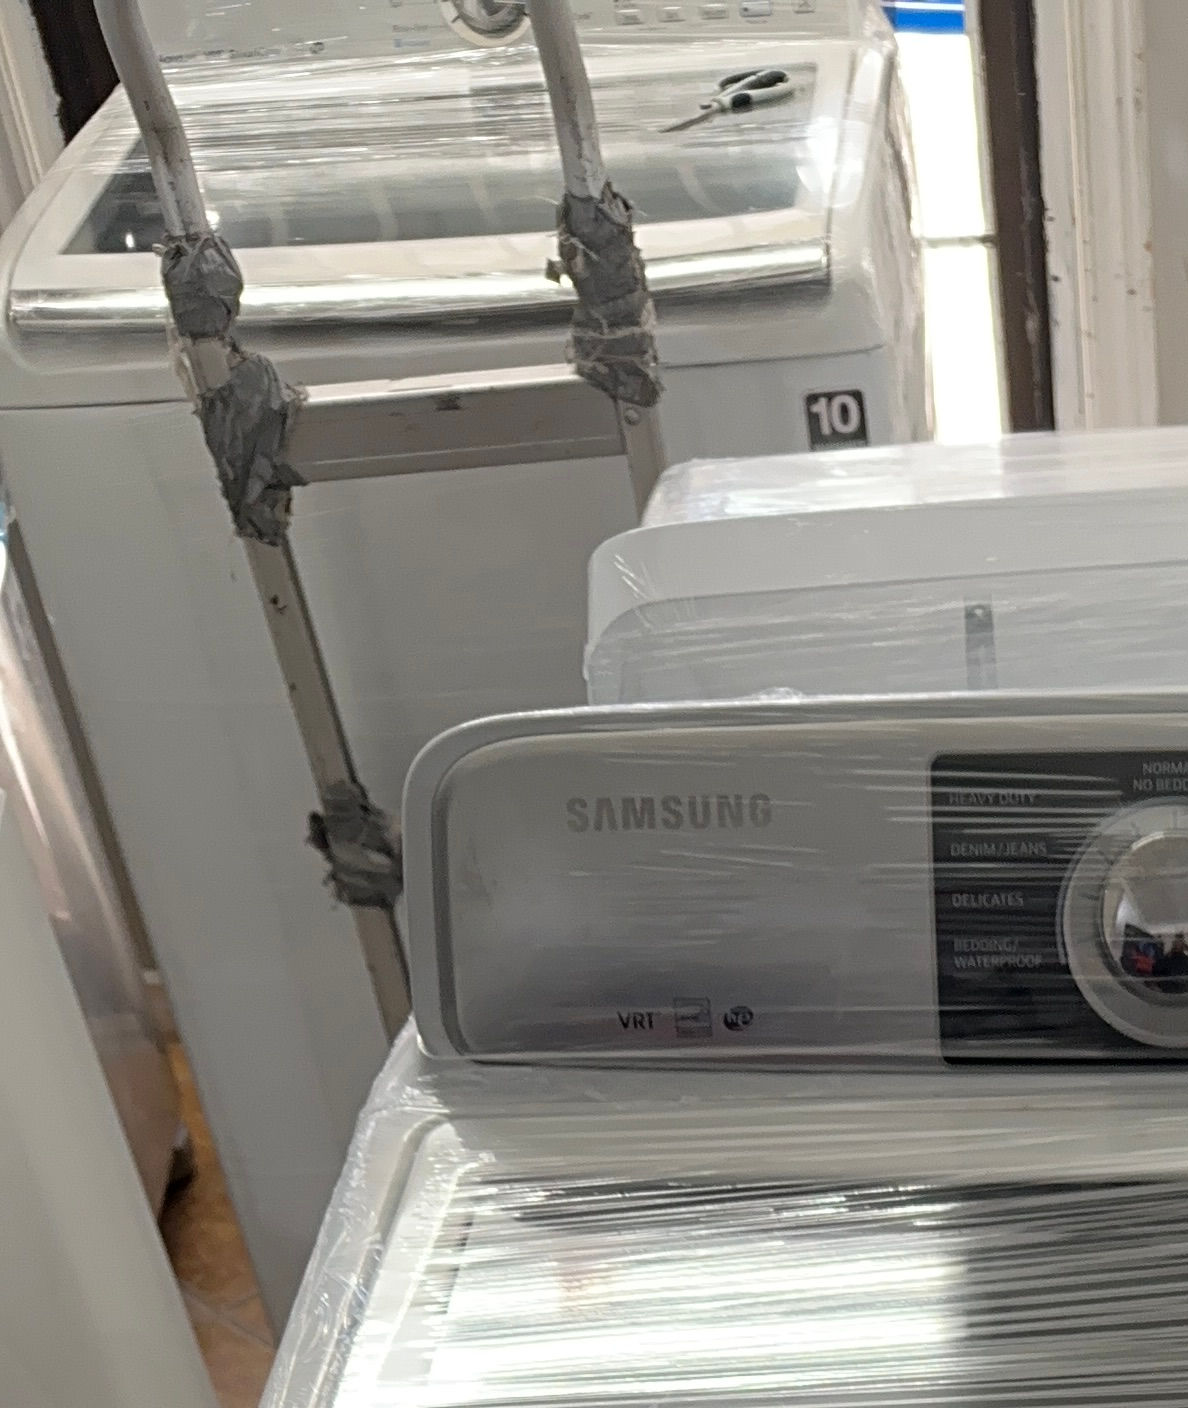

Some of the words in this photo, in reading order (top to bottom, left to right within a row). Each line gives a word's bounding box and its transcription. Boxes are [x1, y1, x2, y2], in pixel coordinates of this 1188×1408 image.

[810, 395, 860, 435] 10
[1133, 778, 1154, 792] NO
[566, 793, 773, 832] SAMSUNG
[950, 842, 997, 857] DENIM
[1002, 842, 1047, 857] JEANS
[952, 891, 1024, 908] DELICATES
[954, 954, 1042, 969] WATERPROOF
[617, 1011, 655, 1030] VRT
